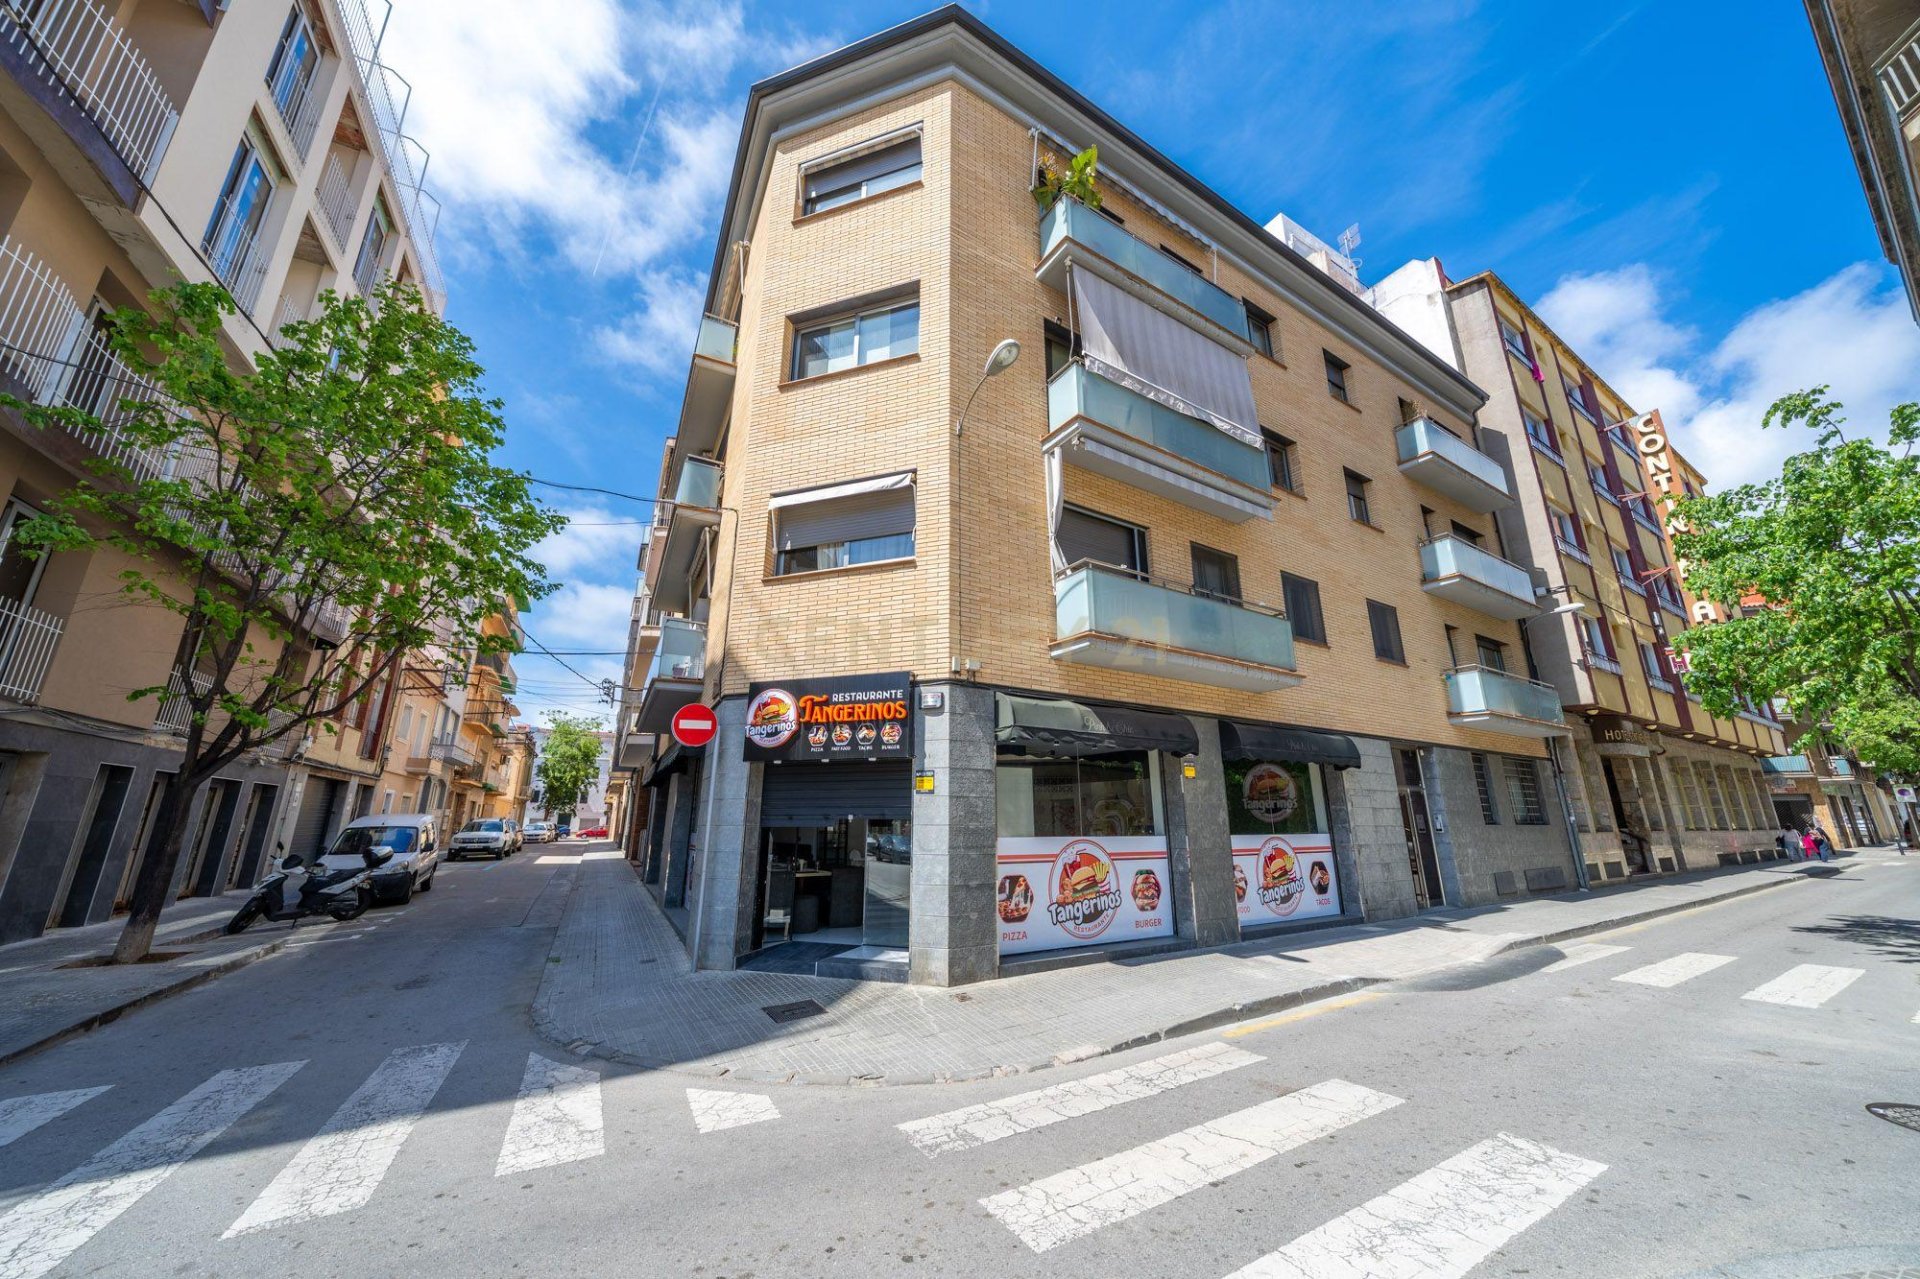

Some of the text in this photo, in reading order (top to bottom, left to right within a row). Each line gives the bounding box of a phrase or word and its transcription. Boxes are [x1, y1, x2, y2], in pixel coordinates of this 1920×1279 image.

[832, 690, 904, 702] RESTAURANTE
[745, 720, 796, 738] Tangerinos
[1256, 877, 1305, 906] Tangerinos
[1047, 889, 1122, 926] Tangerinos
[1073, 913, 1110, 933] RESTAURANTE
[1135, 918, 1162, 929] BURGER
[1002, 930, 1028, 941] PIZZA
